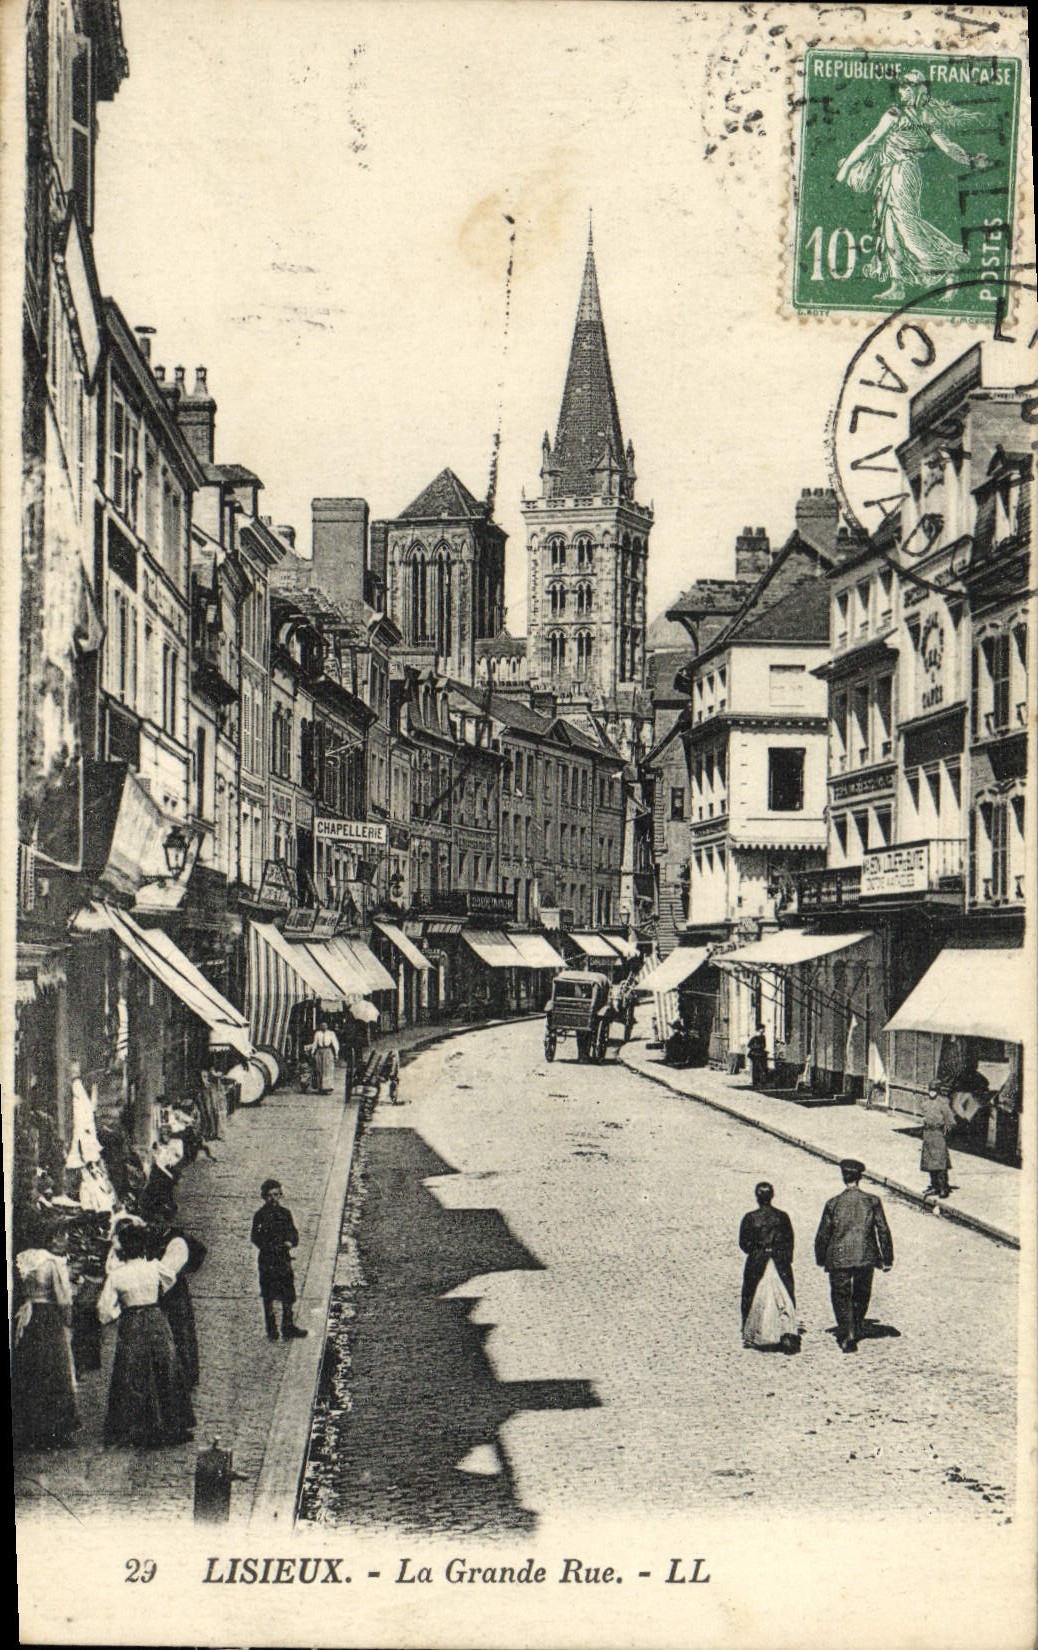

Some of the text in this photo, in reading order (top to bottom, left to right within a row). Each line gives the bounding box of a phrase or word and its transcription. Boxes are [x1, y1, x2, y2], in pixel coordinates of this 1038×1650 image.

[814, 59, 901, 80] REPUBLIQUE
[979, 217, 1003, 302] POSTES
[317, 820, 384, 840] CHAPELLERIE
